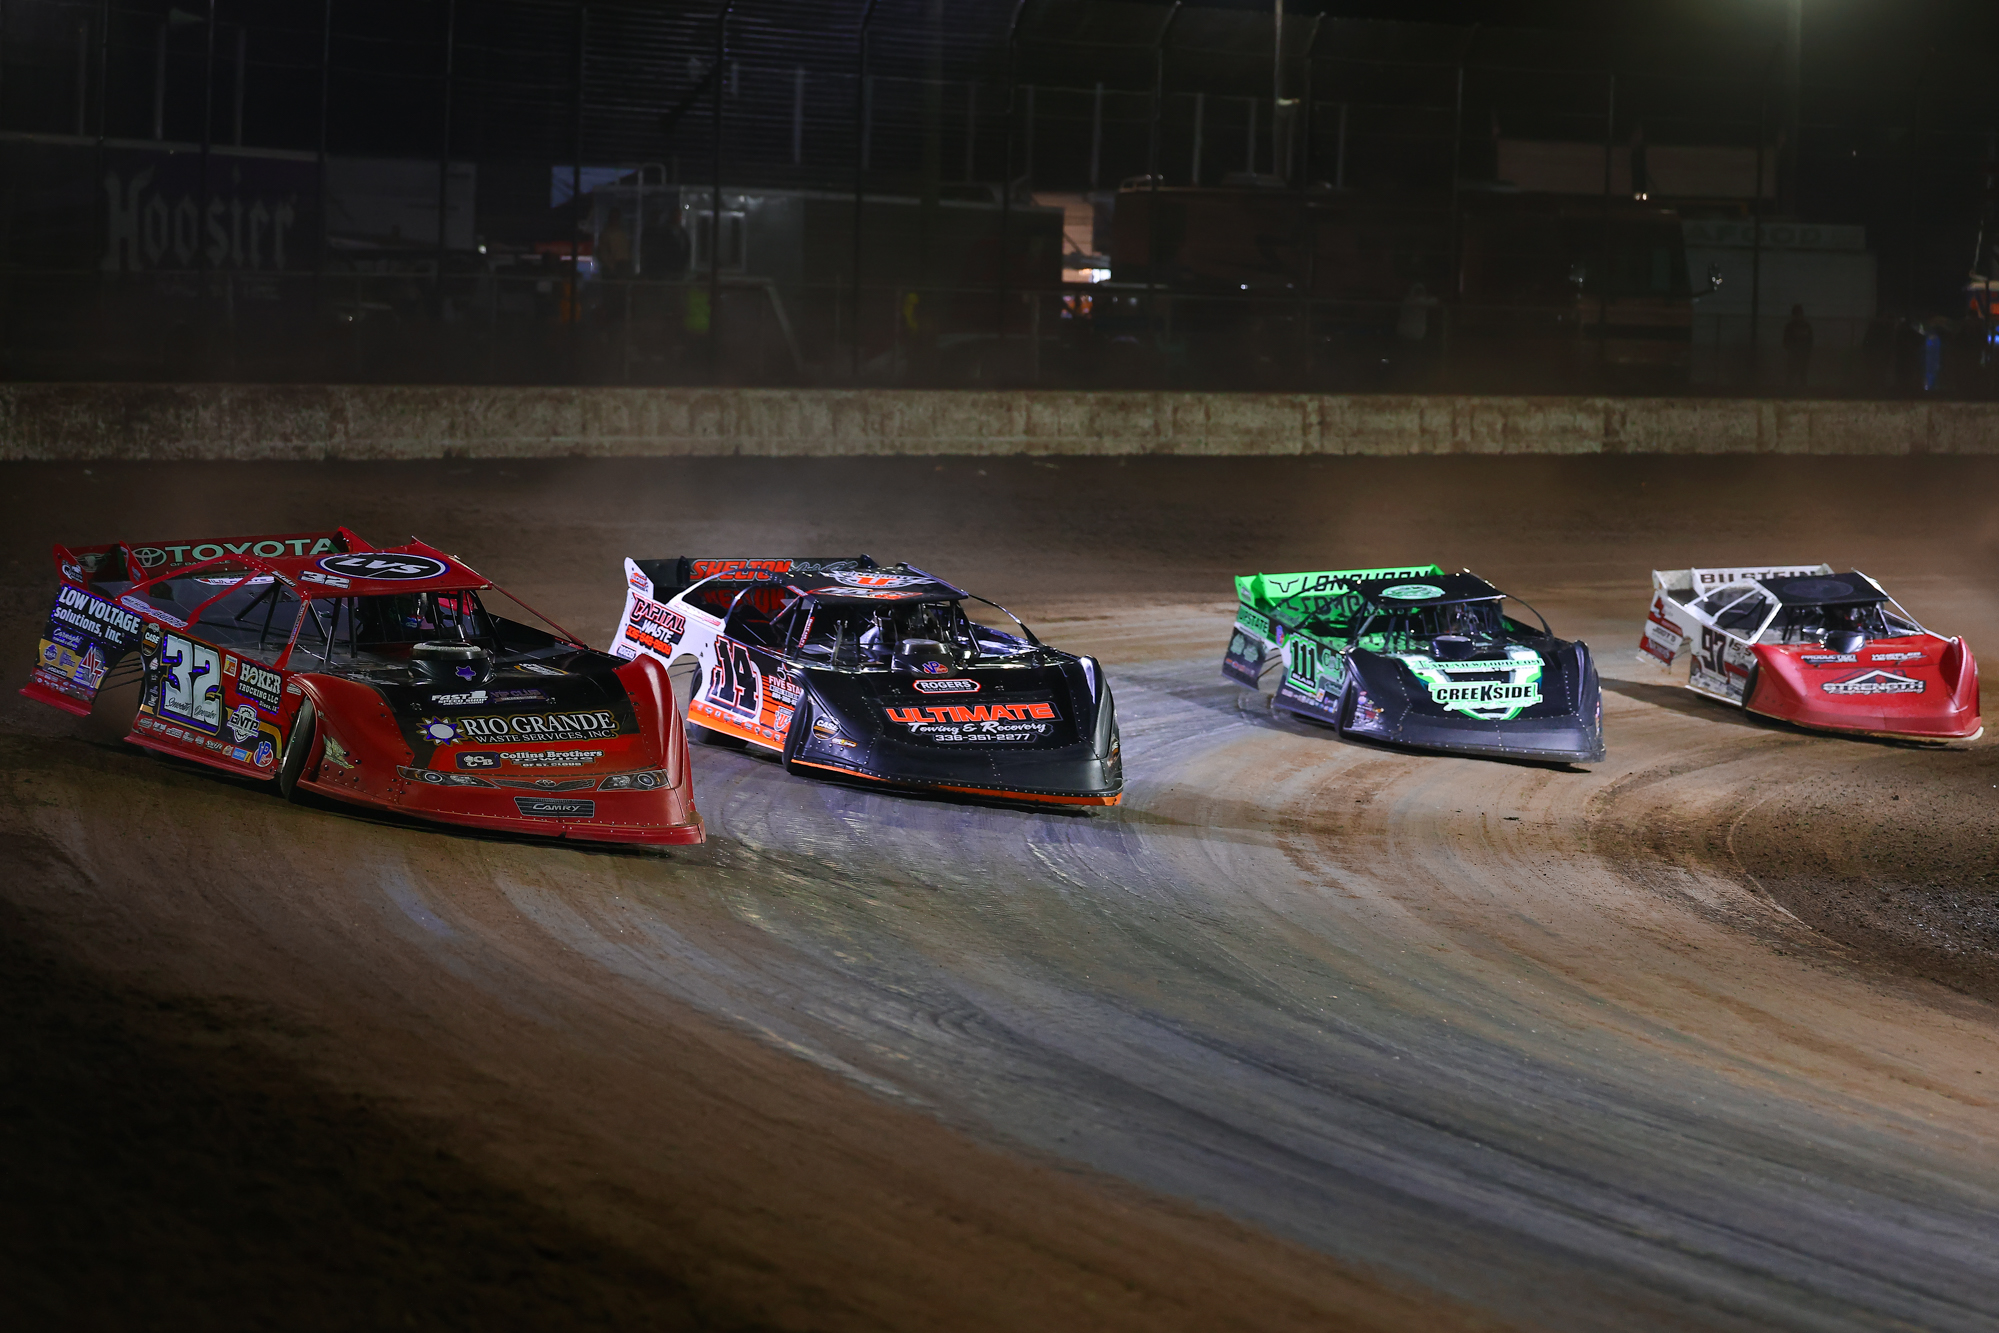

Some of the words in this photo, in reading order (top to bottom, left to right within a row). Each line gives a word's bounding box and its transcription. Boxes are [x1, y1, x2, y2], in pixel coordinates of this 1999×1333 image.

[165, 537, 341, 562] TOYOTA
[300, 570, 350, 589] 32
[690, 560, 792, 580] SHELTON
[59, 586, 90, 611] LOW
[88, 599, 141, 635] VOLTAGE
[630, 594, 685, 634] CAPITAL
[53, 606, 102, 637] solutions,
[105, 626, 122, 645] inc.
[641, 619, 674, 643] WASTE
[145, 632, 160, 644] CASE
[1702, 625, 1727, 678] 97
[922, 661, 940, 673] VP
[1291, 640, 1315, 686] 111
[163, 634, 220, 727] 32
[240, 662, 281, 694] HOKER
[709, 636, 758, 713] 14
[768, 675, 786, 689] FIVE
[786, 682, 801, 695] STA
[920, 681, 972, 689] ROGERS
[239, 682, 267, 700] TRUCKING
[267, 693, 279, 704] LLC
[1437, 685, 1532, 701] CREEKSIDE
[1822, 681, 1924, 691] STRENGTH
[431, 693, 470, 701] FAST
[886, 703, 1056, 722] ULTIMATE
[461, 717, 508, 736] RIO
[511, 712, 616, 734] GRANDE
[908, 722, 959, 735] Towing
[962, 723, 978, 732] &
[979, 721, 1047, 733] Recovery
[475, 734, 521, 743] WASTE
[522, 732, 587, 742] SERVICES,
[588, 729, 615, 738] INC.
[256, 741, 272, 764] VP
[533, 803, 580, 812] CAMRY
